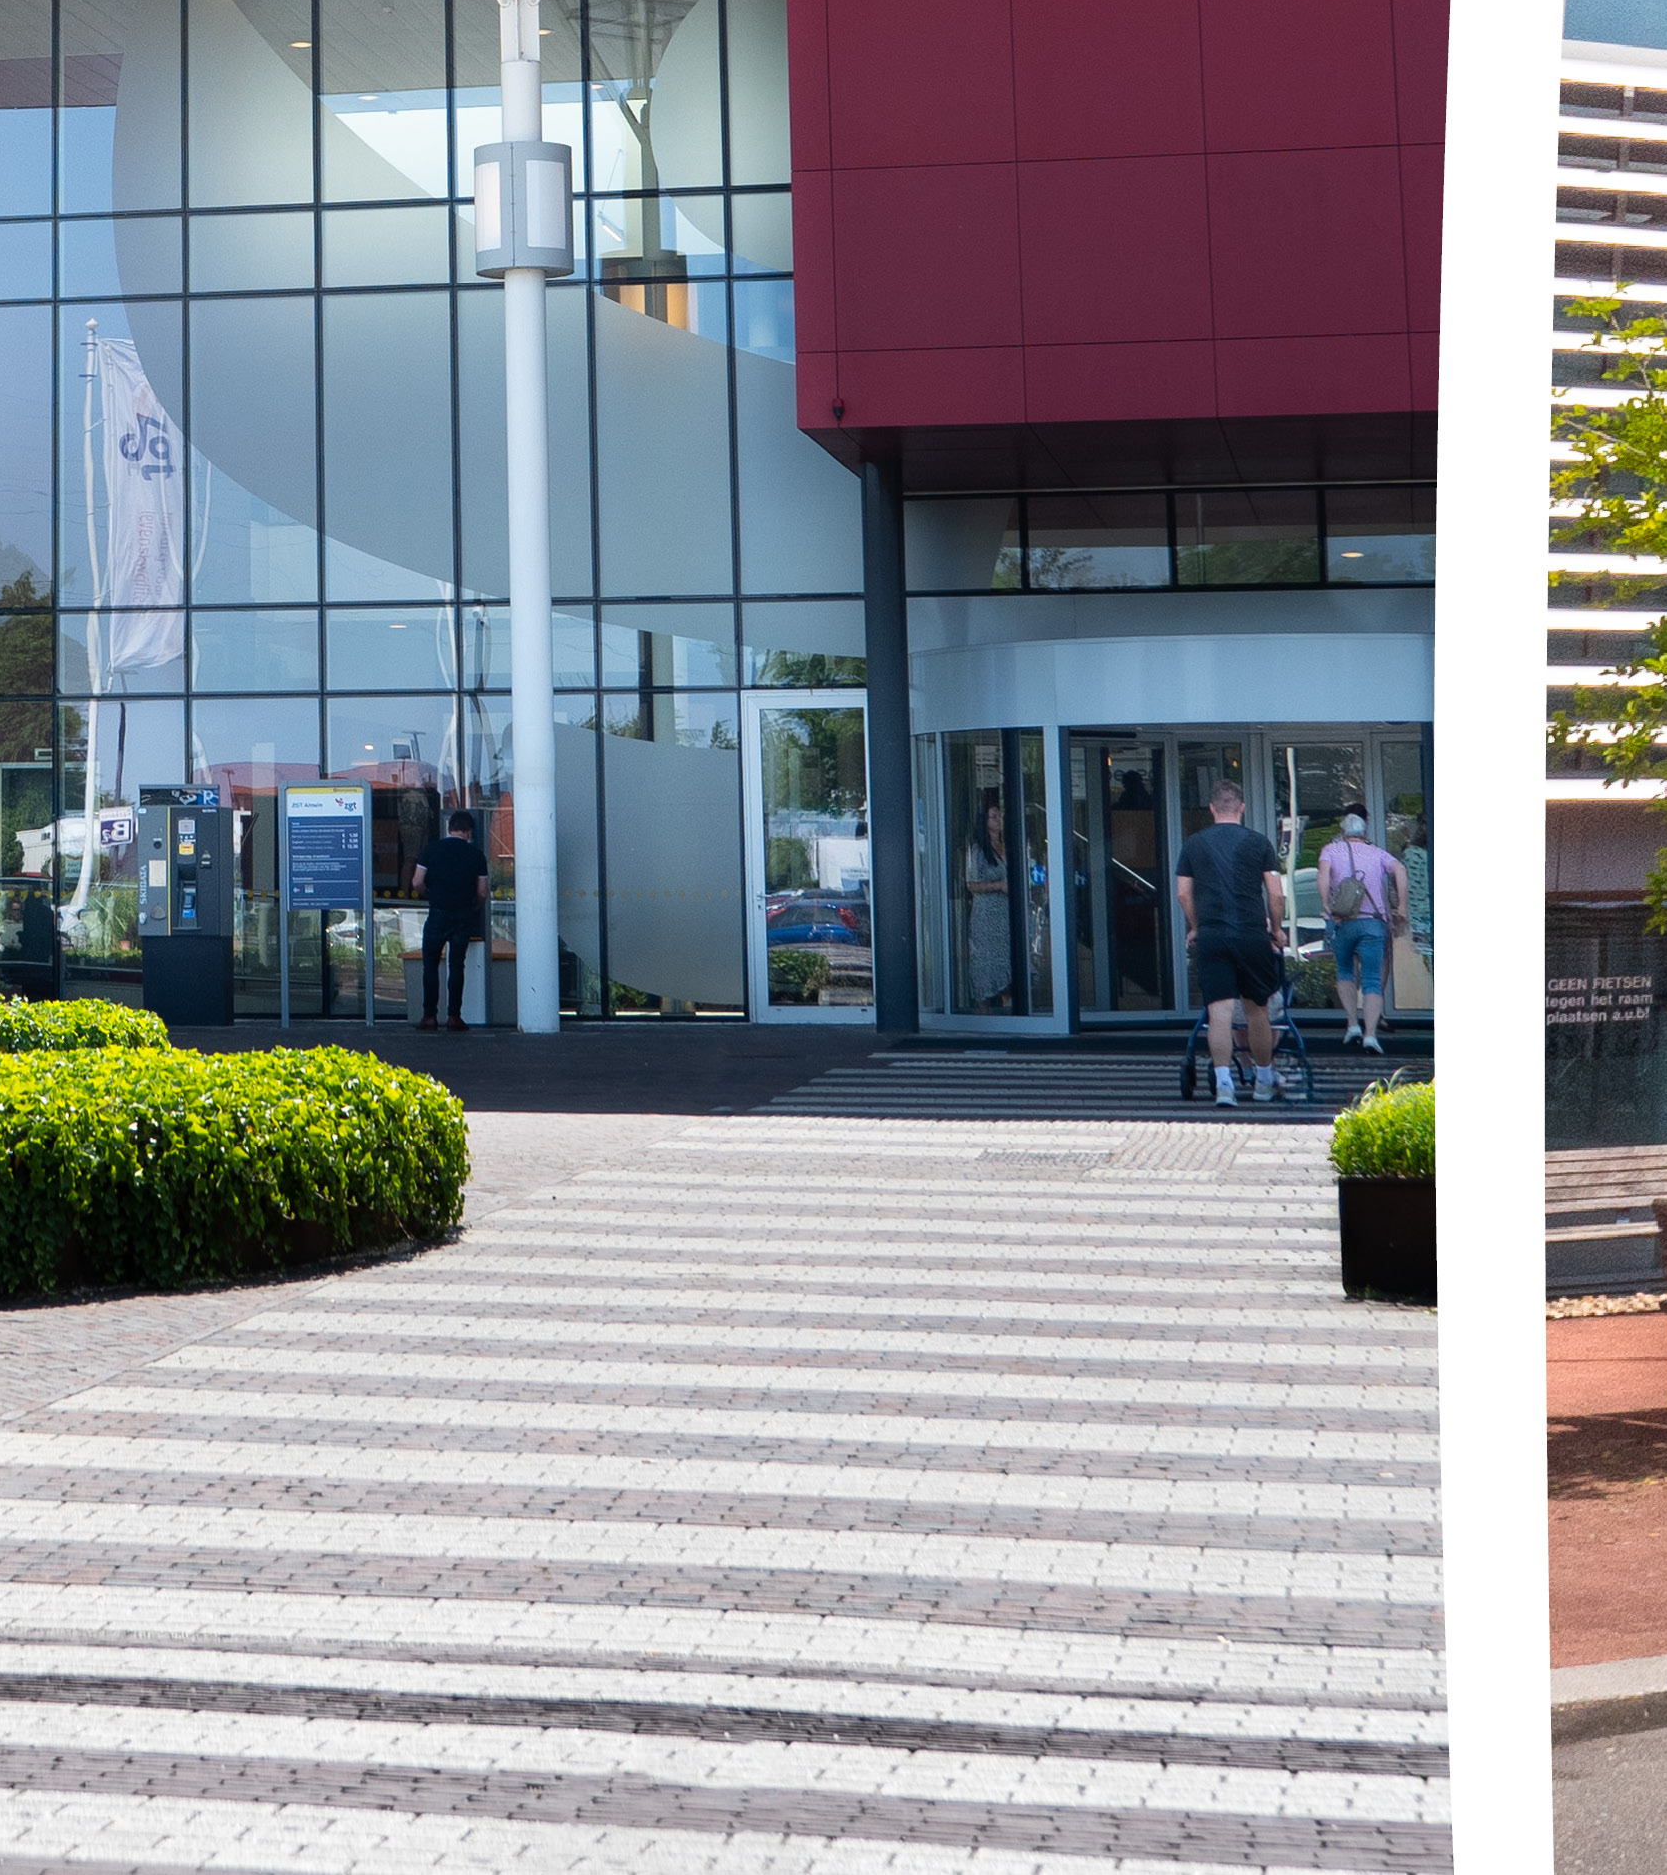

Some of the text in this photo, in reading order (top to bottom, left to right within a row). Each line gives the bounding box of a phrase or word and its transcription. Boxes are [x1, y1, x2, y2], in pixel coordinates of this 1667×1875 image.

[1547, 975, 1652, 992] GEEN FIETSEN
[1545, 994, 1654, 1009] tegen het raam
[1546, 1009, 1608, 1026] plaatsen
